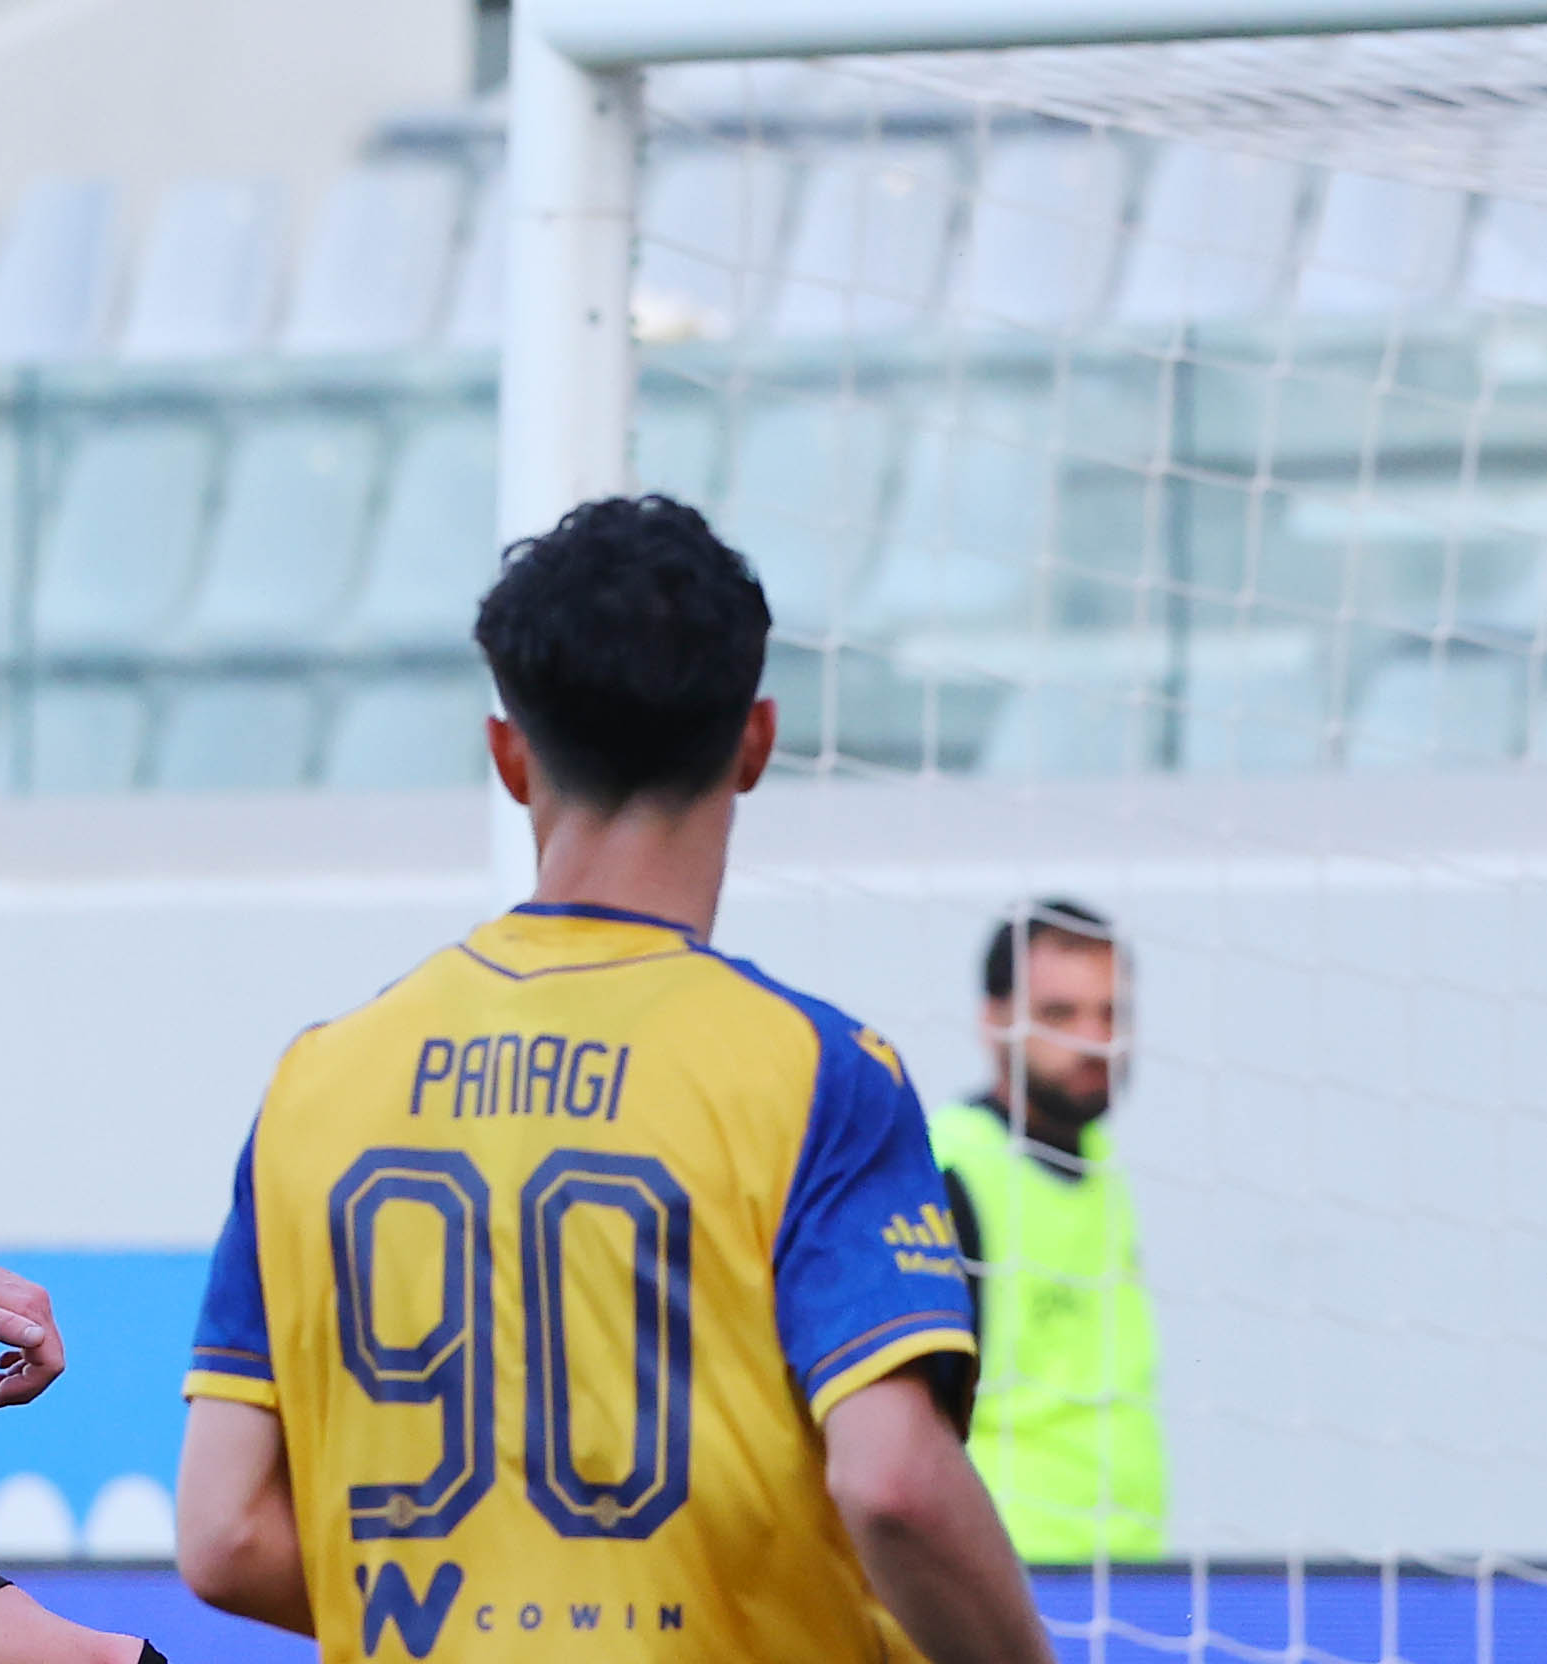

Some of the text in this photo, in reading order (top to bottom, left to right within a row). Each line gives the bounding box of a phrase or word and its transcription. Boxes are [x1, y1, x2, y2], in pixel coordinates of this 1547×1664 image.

[409, 1033, 631, 1122] PANAGI
[328, 1147, 692, 1541] 90
[475, 1602, 683, 1632] COWIN
